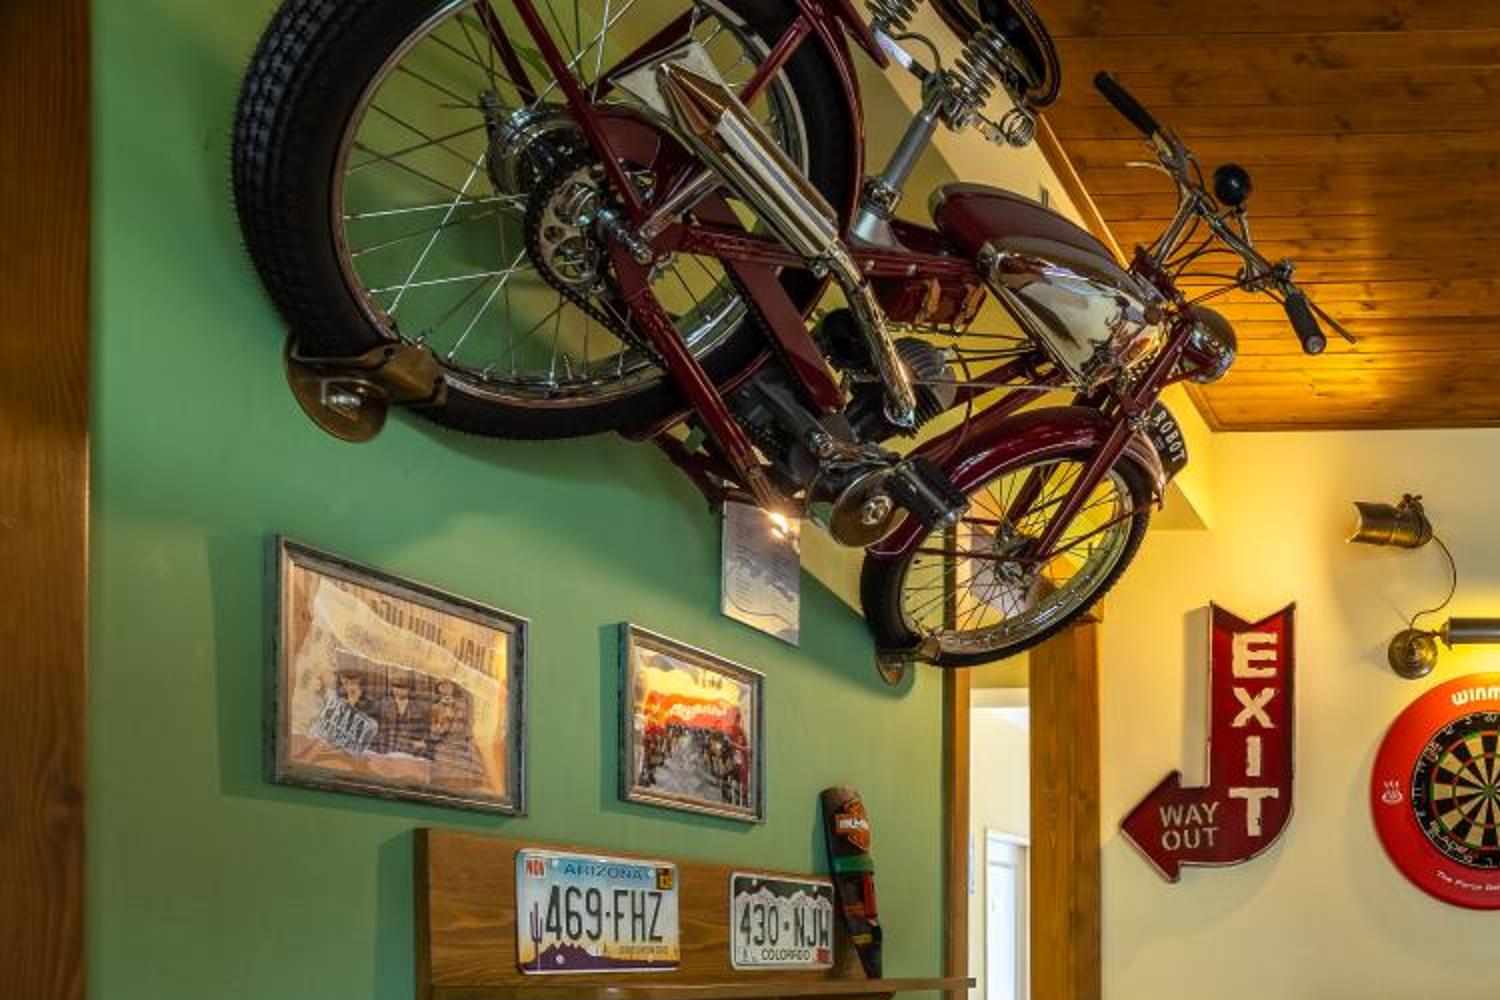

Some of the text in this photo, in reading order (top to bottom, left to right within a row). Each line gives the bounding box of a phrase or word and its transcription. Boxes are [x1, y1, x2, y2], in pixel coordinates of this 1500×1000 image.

[1153, 409, 1185, 462] ROBOT
[1228, 631, 1279, 837] EXIT
[1159, 801, 1220, 827] WAY
[1161, 827, 1219, 851] OUT
[563, 863, 643, 881] ARIZONA
[761, 949, 811, 961] COLORADO
